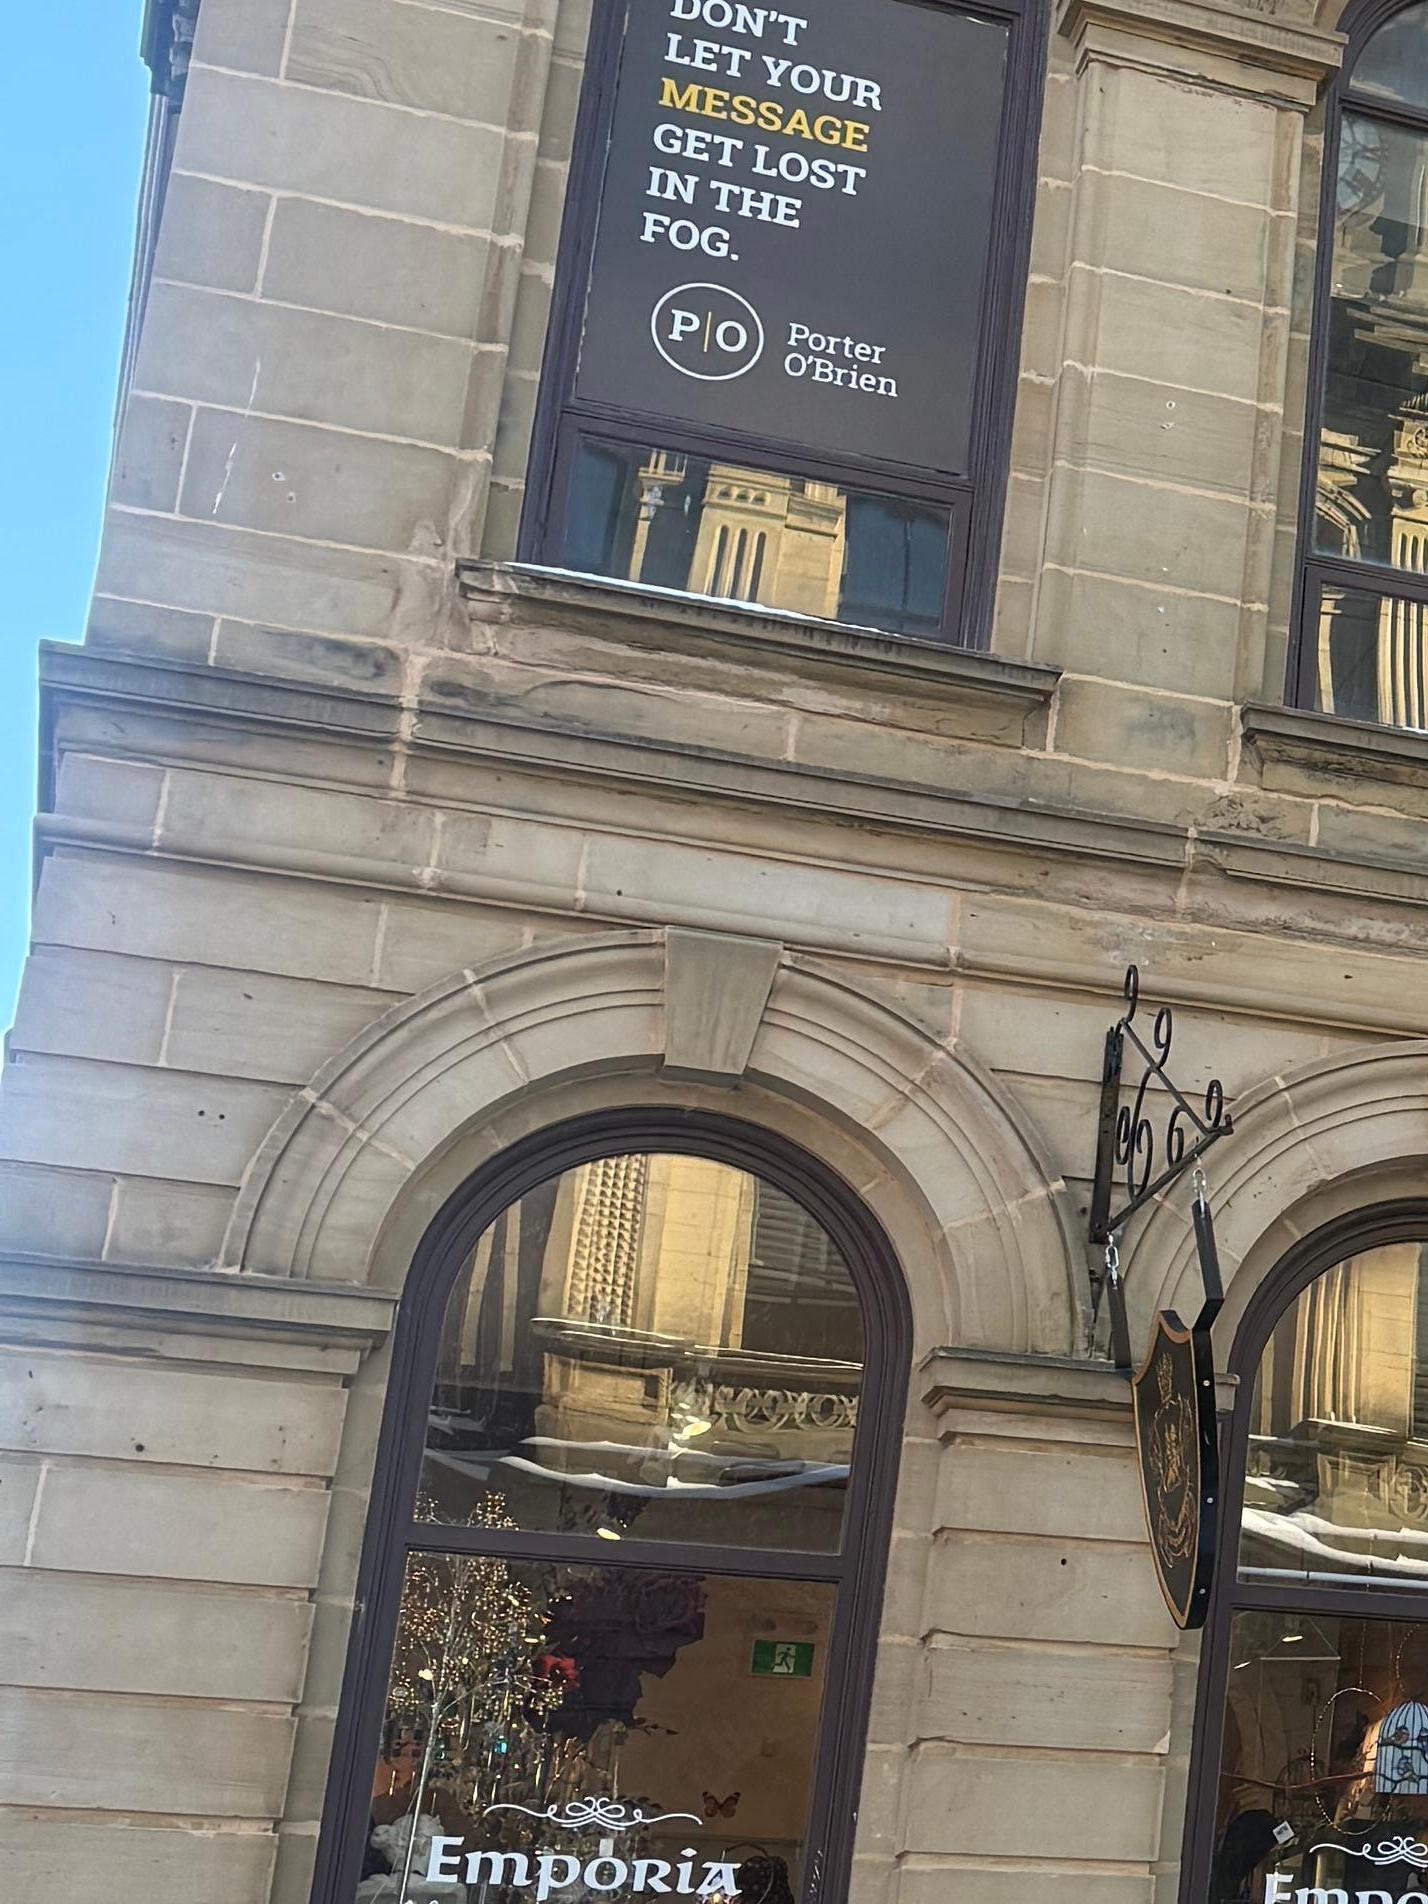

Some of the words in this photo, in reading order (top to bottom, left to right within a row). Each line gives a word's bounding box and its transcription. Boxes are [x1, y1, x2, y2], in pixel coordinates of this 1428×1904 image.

[664, 32, 752, 78] LET
[762, 55, 882, 111] YOUR
[658, 77, 870, 152] MESSAGE
[653, 123, 743, 168] GET
[752, 145, 867, 196] LOST
[646, 166, 700, 205] IN
[710, 180, 802, 228] THE
[640, 211, 739, 261] FOG.
[784, 352, 899, 397] O'Brien
[787, 322, 887, 364] Porter
[425, 1835, 743, 1902] Emporia
